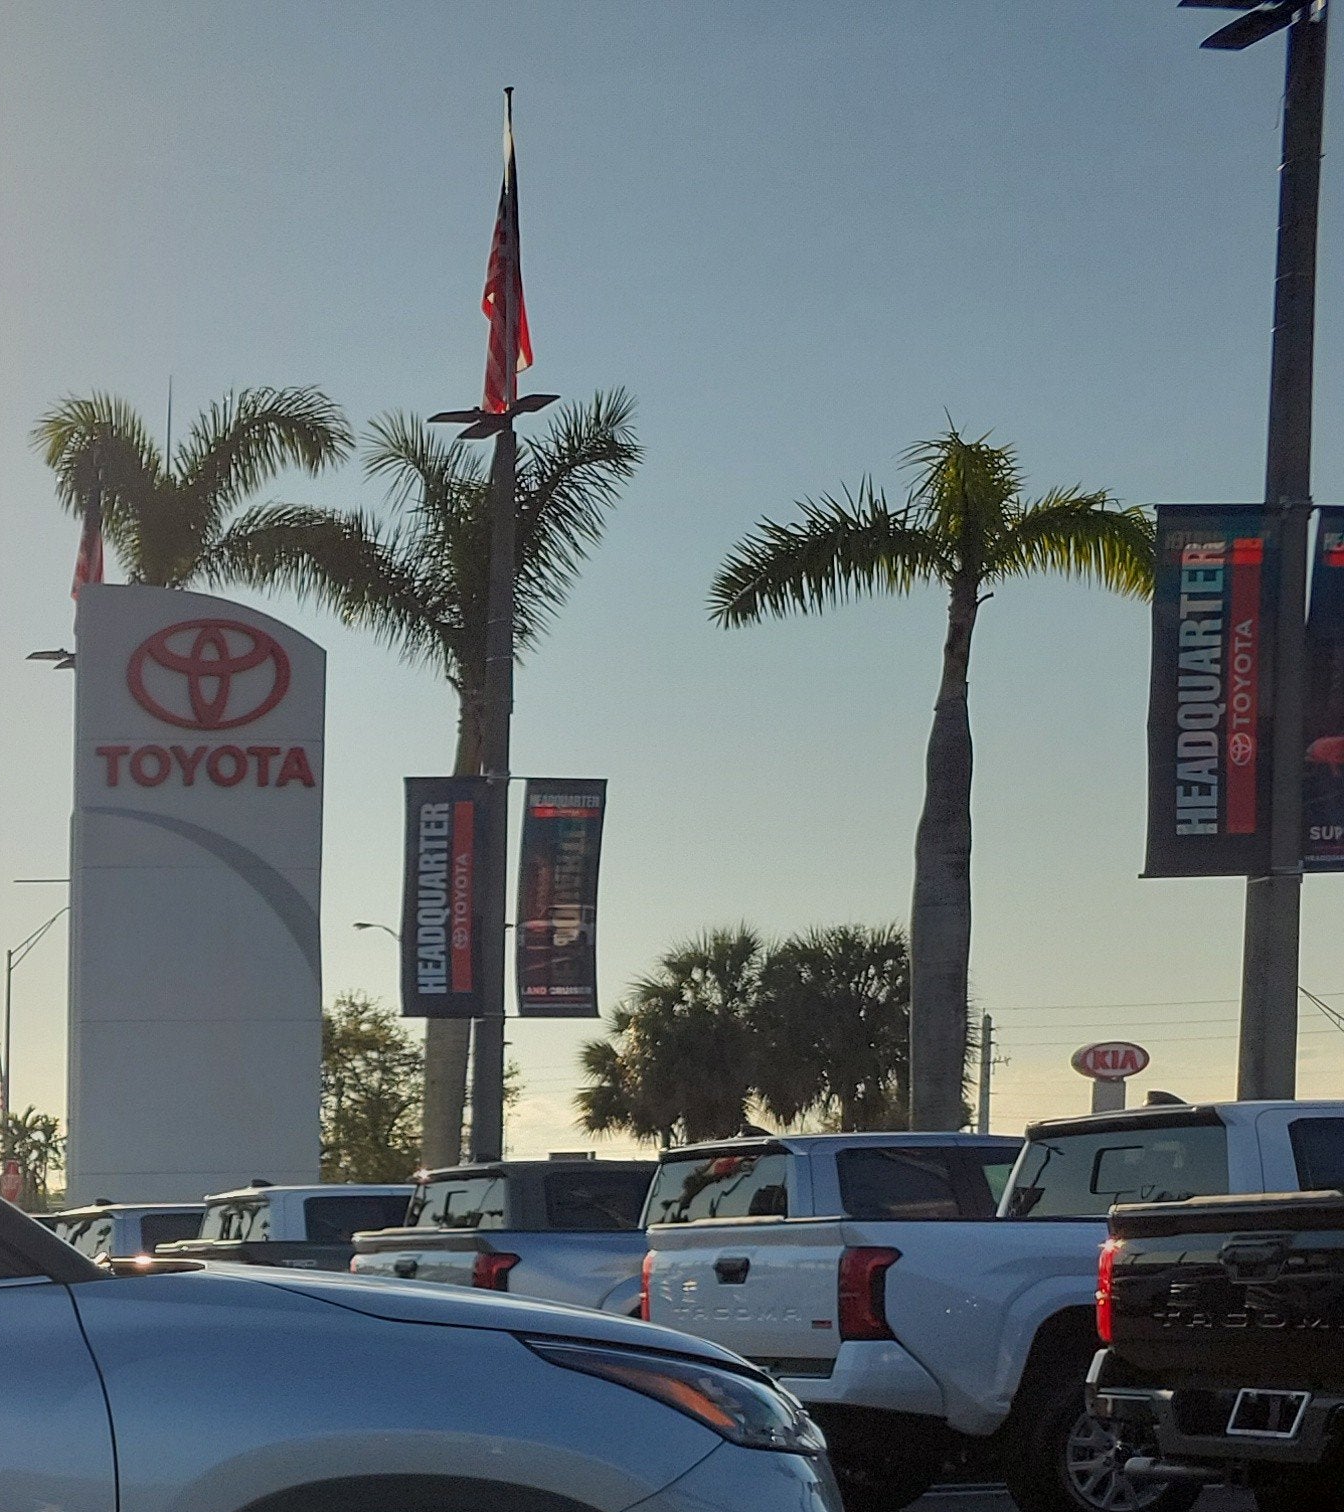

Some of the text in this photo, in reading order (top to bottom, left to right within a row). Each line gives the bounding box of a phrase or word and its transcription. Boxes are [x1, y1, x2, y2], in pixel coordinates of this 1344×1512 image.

[1175, 539, 1226, 836] HEADQUARTER
[1232, 619, 1254, 728] TOYOTA
[96, 744, 316, 788] TOYOTA
[417, 803, 450, 994] HEADQUARTER
[453, 853, 469, 925] TOYOTA
[1092, 1049, 1139, 1070] KIA
